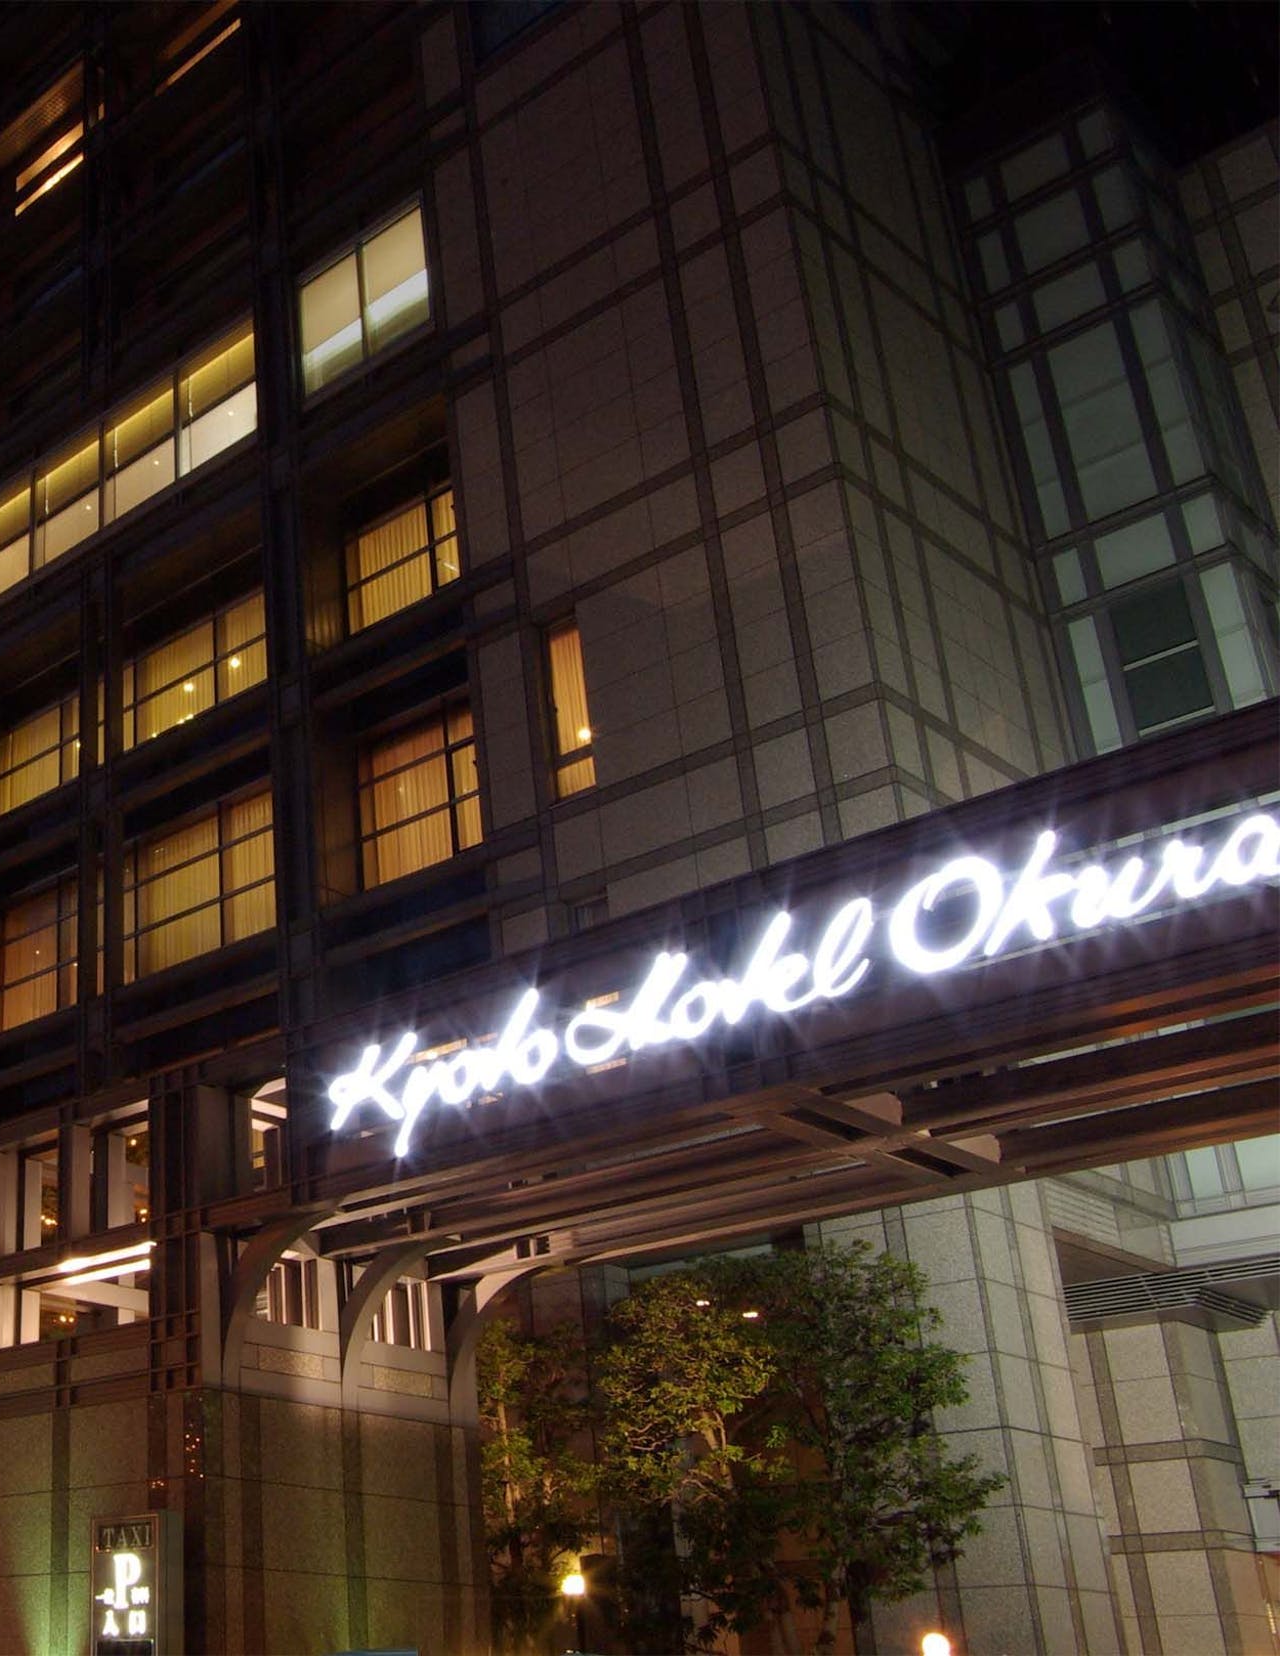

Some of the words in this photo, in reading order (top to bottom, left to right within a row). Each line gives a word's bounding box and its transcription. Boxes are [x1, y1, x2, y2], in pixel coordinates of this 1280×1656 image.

[328, 988, 558, 1158] Kyoto
[564, 897, 874, 1066] Hotel
[888, 813, 1280, 974] Okura
[103, 1526, 151, 1548] TAXI
[112, 1552, 142, 1610] P
